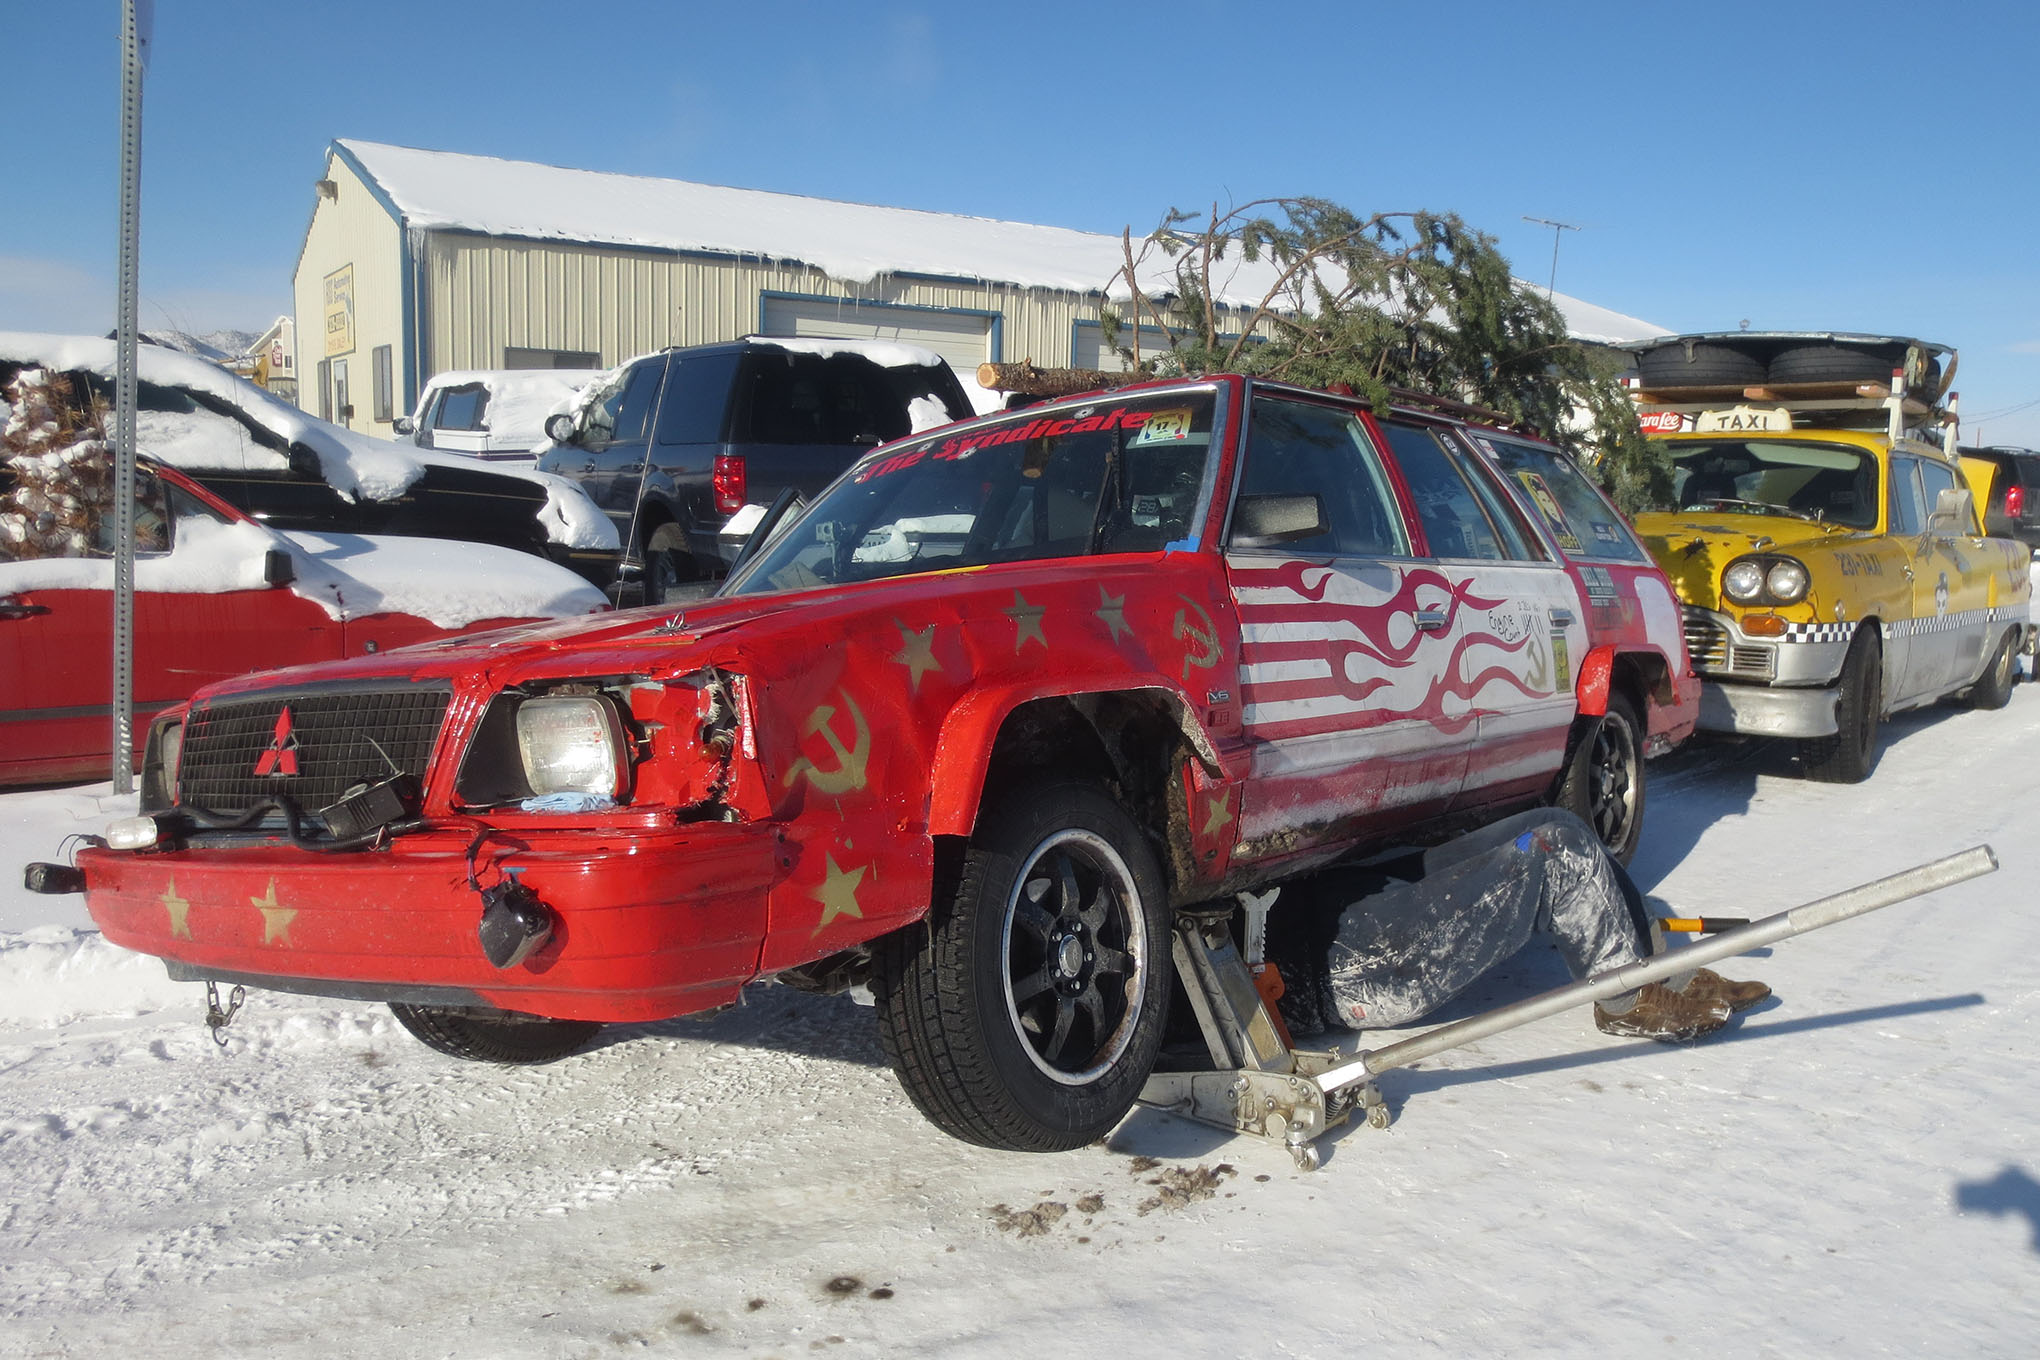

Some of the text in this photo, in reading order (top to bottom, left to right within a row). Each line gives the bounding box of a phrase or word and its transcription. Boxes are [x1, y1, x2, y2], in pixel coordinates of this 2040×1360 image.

[1636, 412, 1680, 430] ara Lee
[1717, 414, 1768, 430] TAXI
[856, 408, 1152, 484] The Syndicate
[1209, 690, 1229, 700] V6
